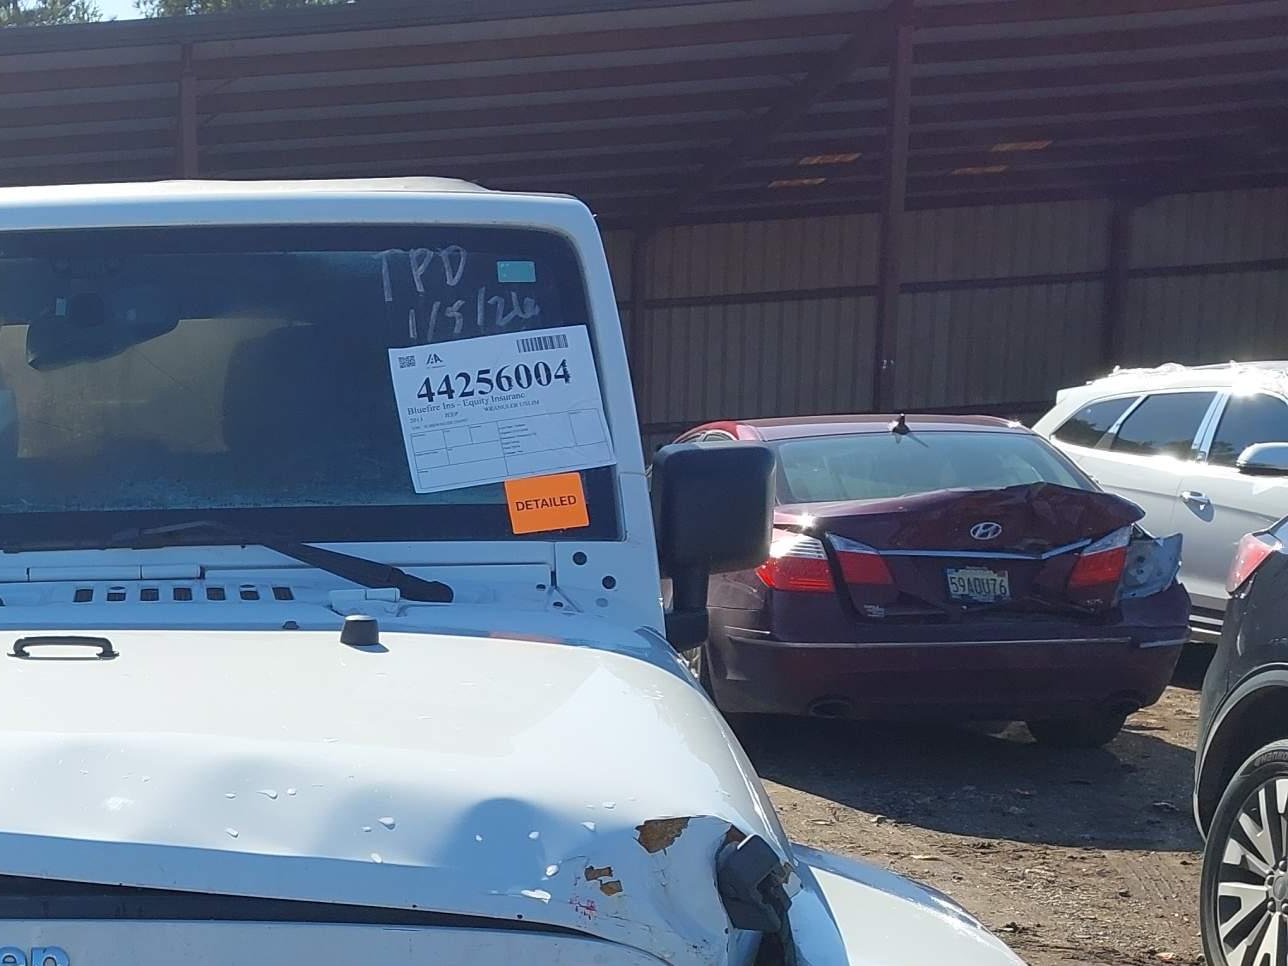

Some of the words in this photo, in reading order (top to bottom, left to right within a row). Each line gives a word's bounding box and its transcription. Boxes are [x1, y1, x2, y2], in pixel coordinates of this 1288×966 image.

[377, 245, 468, 302] TPD
[416, 359, 571, 403] 44256004
[407, 404, 441, 416] Bluefire
[442, 402, 456, 410] Ins
[463, 396, 489, 408] Equity
[515, 495, 577, 512] DETAILED
